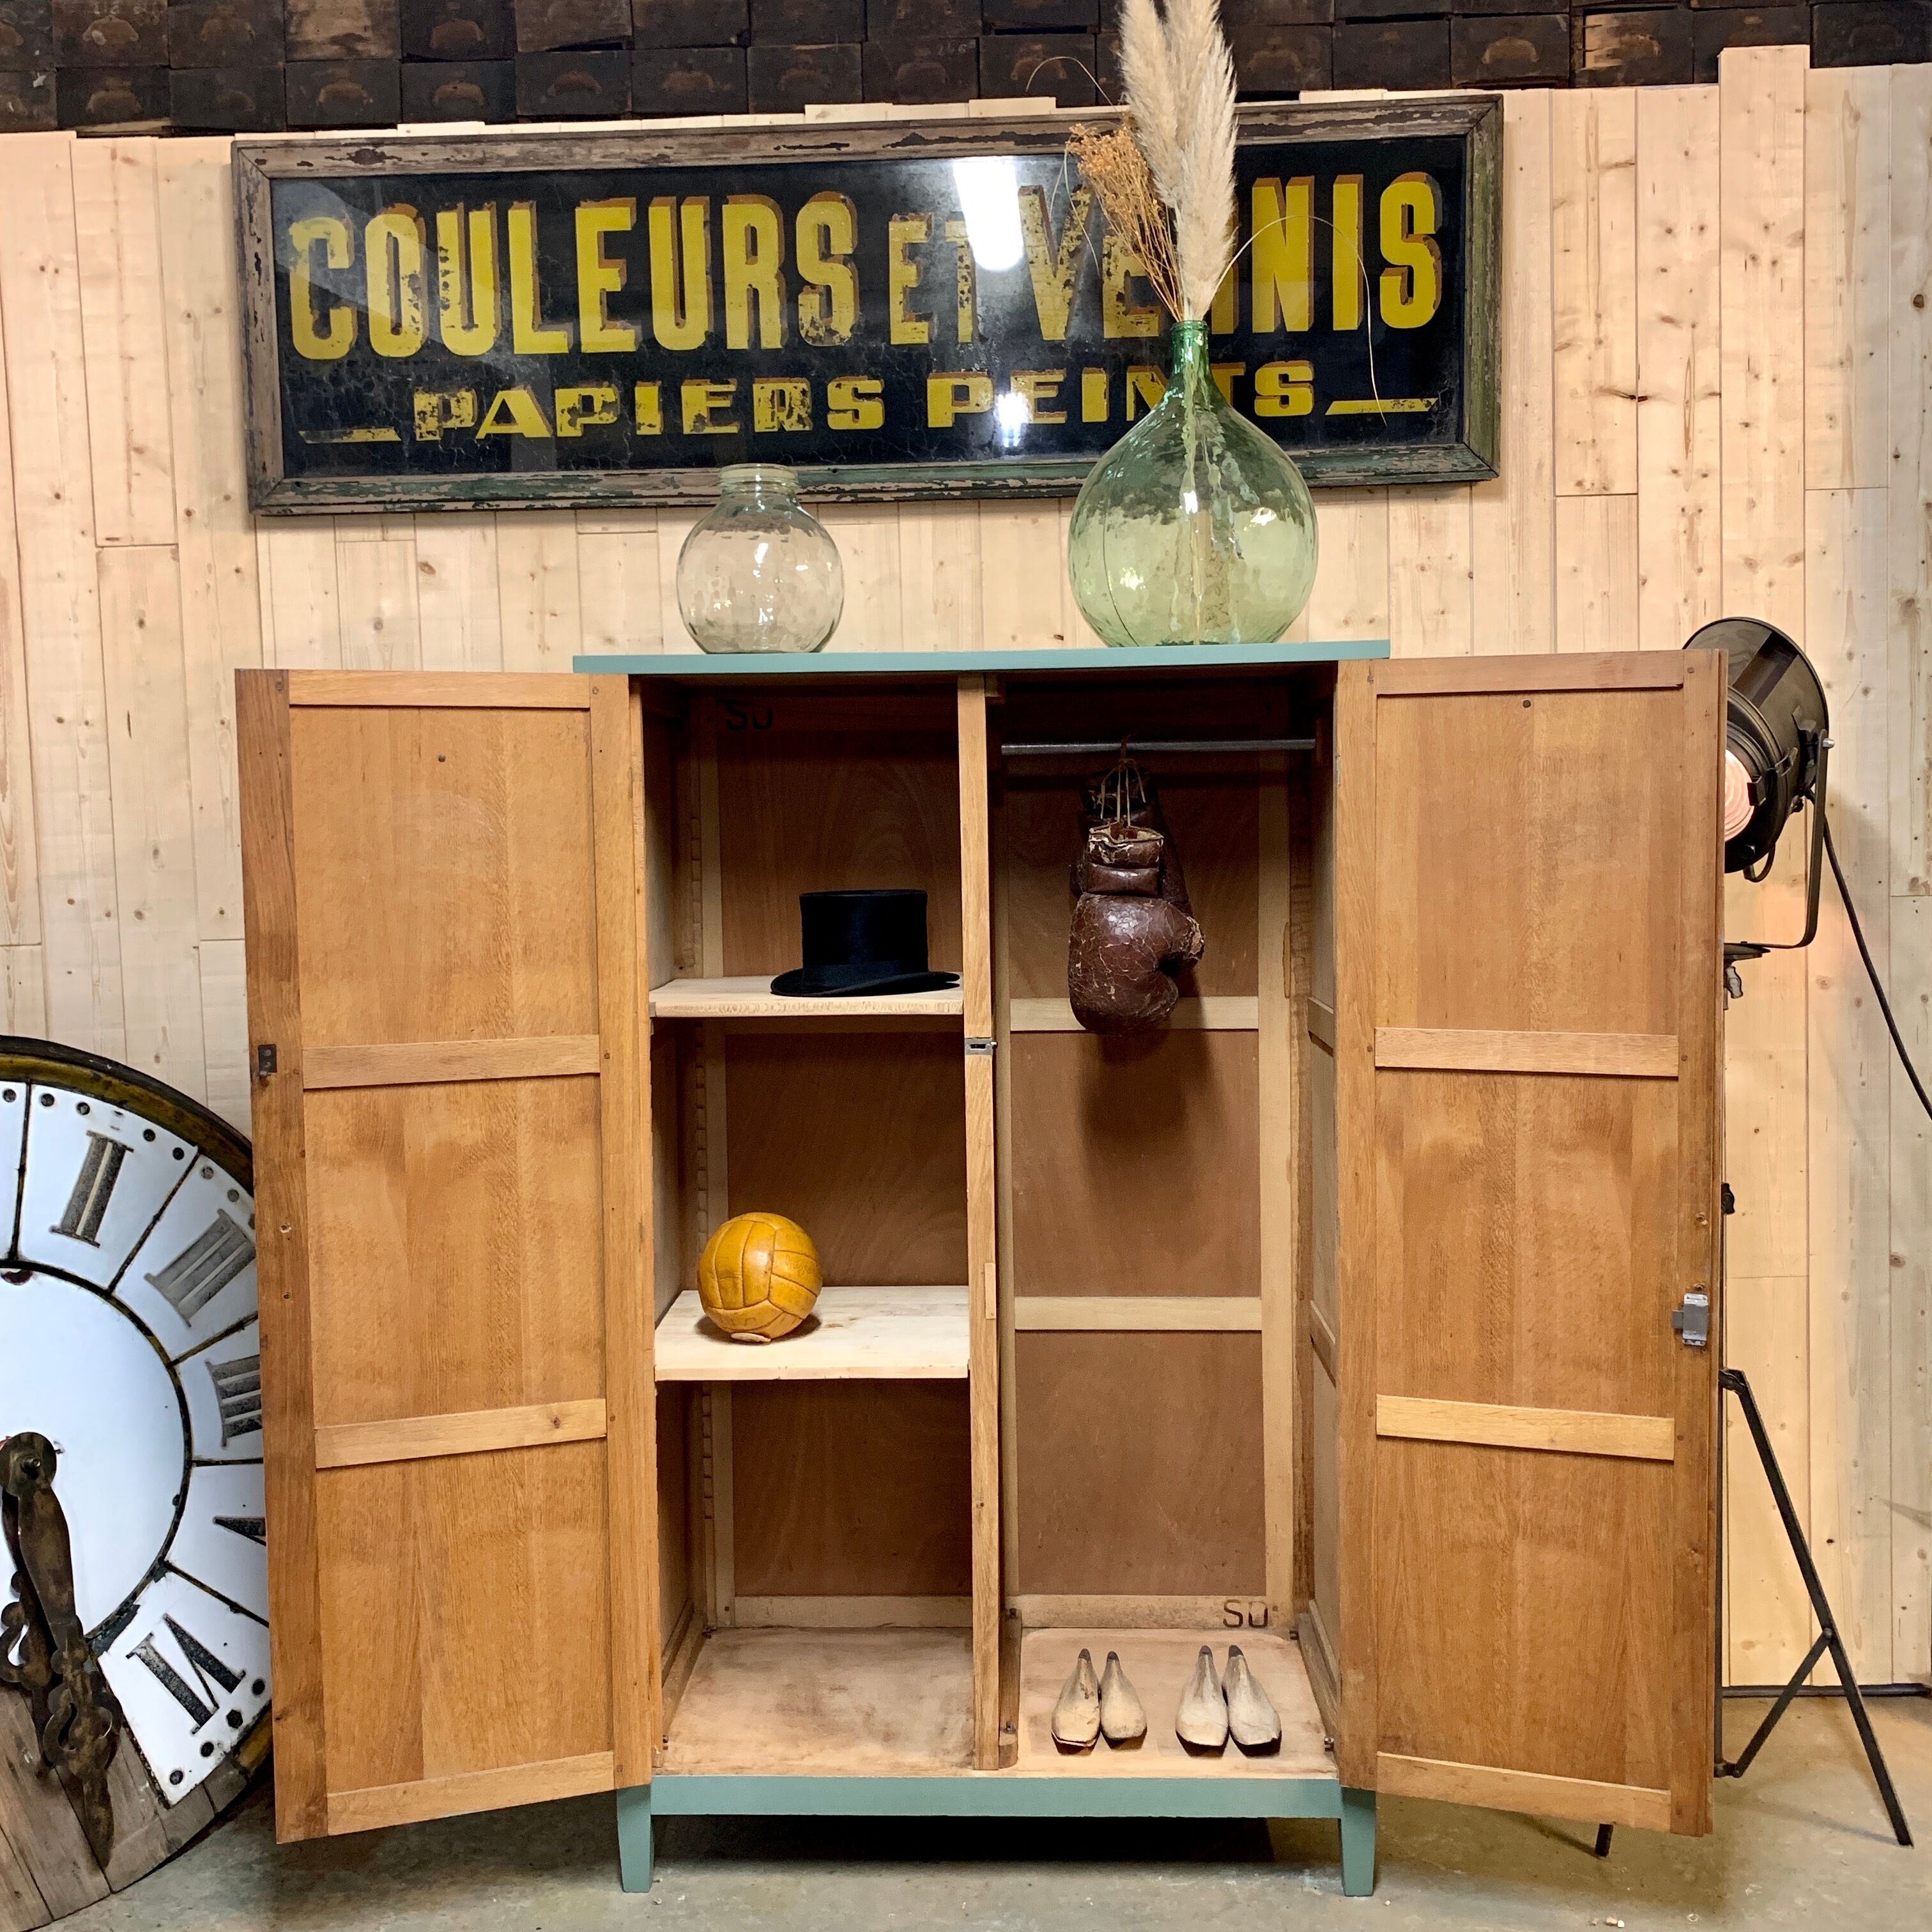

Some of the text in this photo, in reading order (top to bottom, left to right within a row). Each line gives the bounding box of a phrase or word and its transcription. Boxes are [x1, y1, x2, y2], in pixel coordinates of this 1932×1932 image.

[288, 190, 858, 360] COULEURS
[1018, 171, 1443, 340] VENIS
[413, 375, 885, 441] PAPIERS
